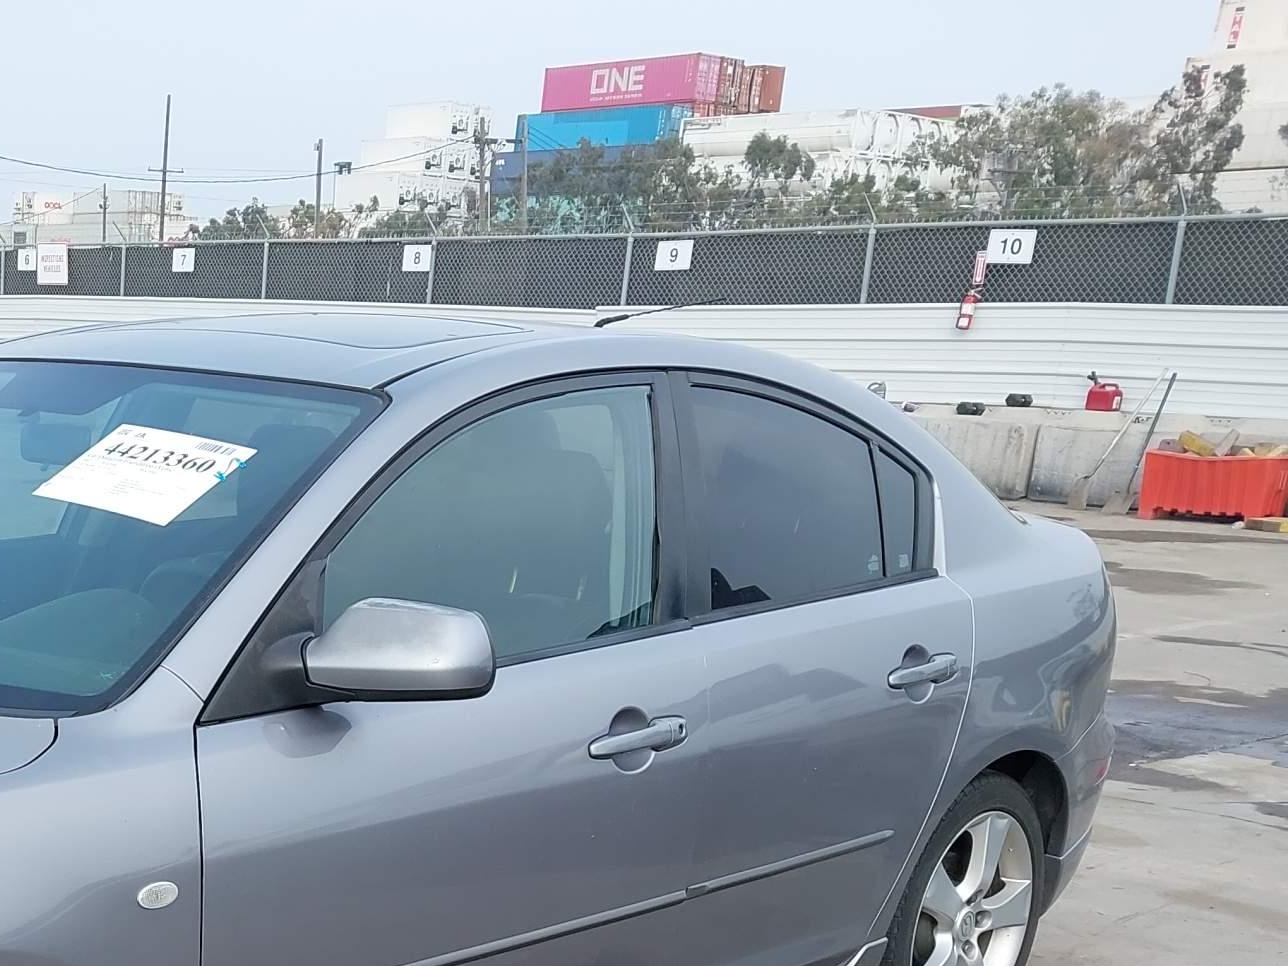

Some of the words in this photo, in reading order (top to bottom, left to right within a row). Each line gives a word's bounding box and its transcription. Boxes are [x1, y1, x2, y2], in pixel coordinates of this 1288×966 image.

[591, 65, 646, 95] ONE
[1000, 237, 1023, 255] 10
[24, 254, 31, 265] 6
[180, 254, 187, 266] 7
[413, 251, 421, 265] 8
[669, 247, 679, 263] 9
[104, 442, 217, 473] 44213360
